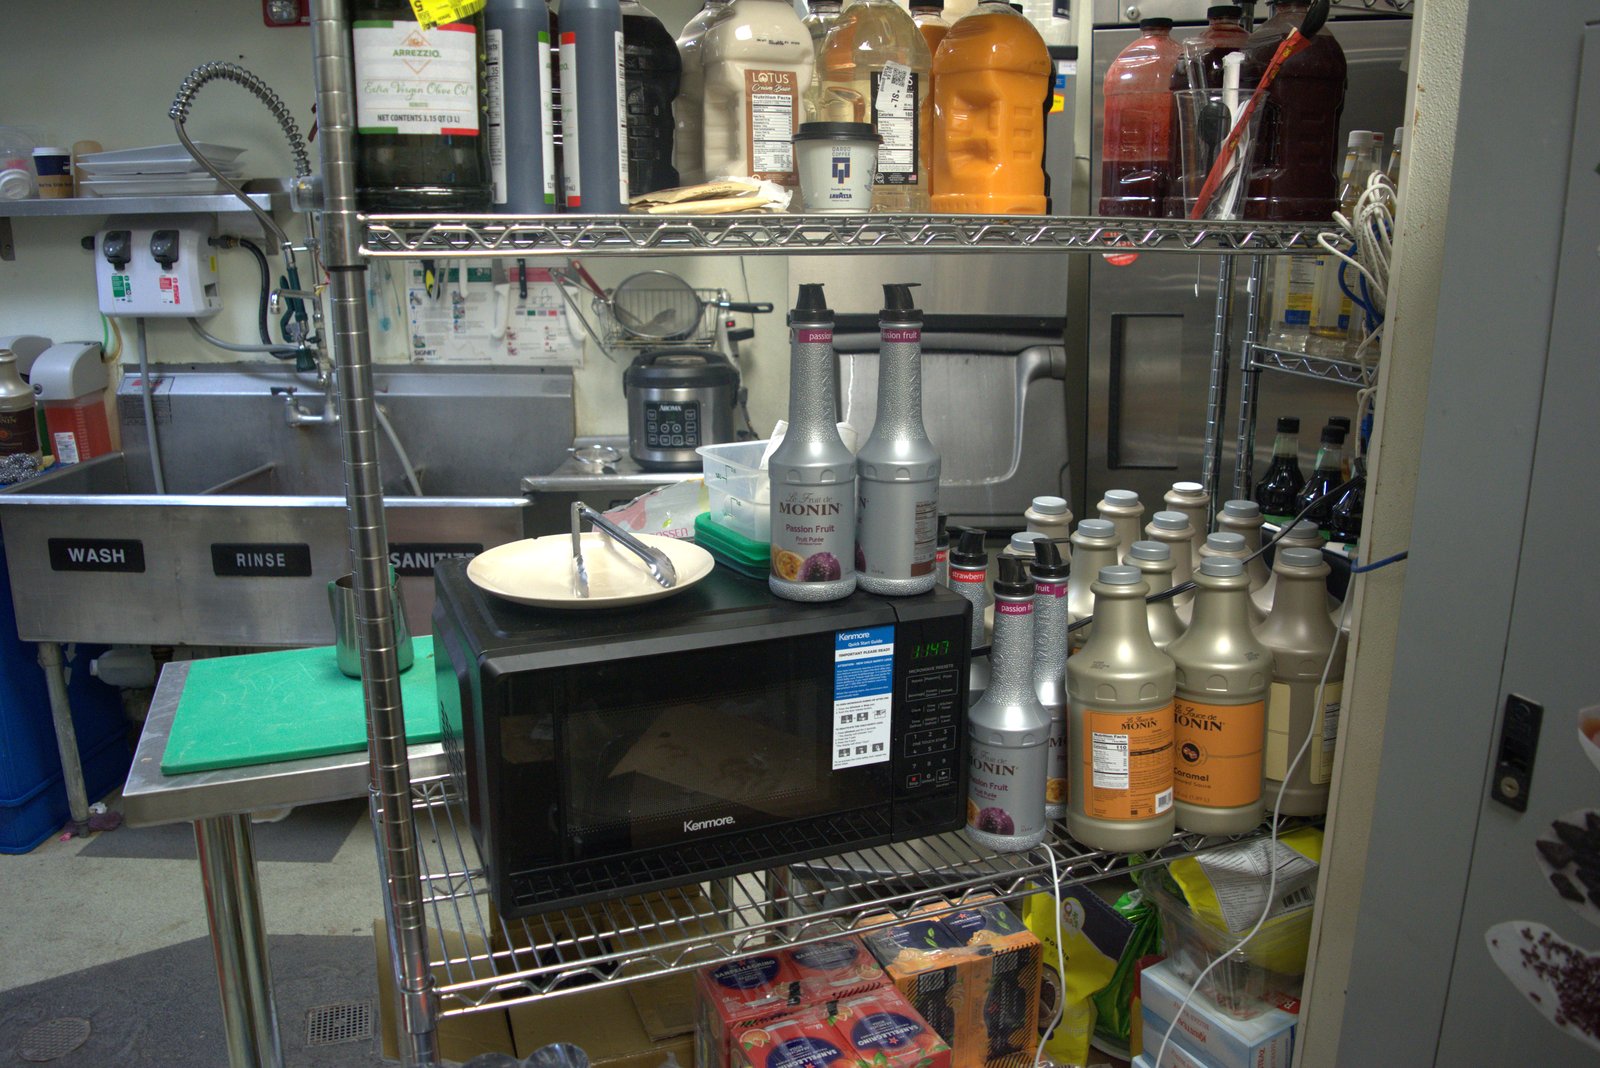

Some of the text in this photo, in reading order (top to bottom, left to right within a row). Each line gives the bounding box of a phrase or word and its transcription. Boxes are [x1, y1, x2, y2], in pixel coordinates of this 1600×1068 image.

[752, 72, 790, 84] LOTUS
[364, 81, 389, 94] Extra
[391, 81, 424, 101] Virgin
[426, 82, 451, 95] Olive
[377, 114, 461, 124] NET CONTENTS 3.15 QT (3 L)
[902, 330, 918, 339] fruit
[779, 502, 841, 516] MONIN
[655, 527, 689, 538] OSSEN
[785, 524, 835, 533] Passion Fruit
[67, 548, 126, 563] WASH
[236, 553, 286, 568] RINSE
[952, 571, 985, 580] strawberry
[1001, 604, 1027, 613] passion
[838, 632, 871, 641] Kenmore
[1121, 720, 1157, 730] MONIN
[1175, 713, 1223, 732] ONIN
[970, 756, 1014, 776] ONIN
[989, 782, 1009, 791] Fruit
[683, 816, 736, 832] Kenmore
[857, 1025, 919, 1046] SANPELLEGRINO
